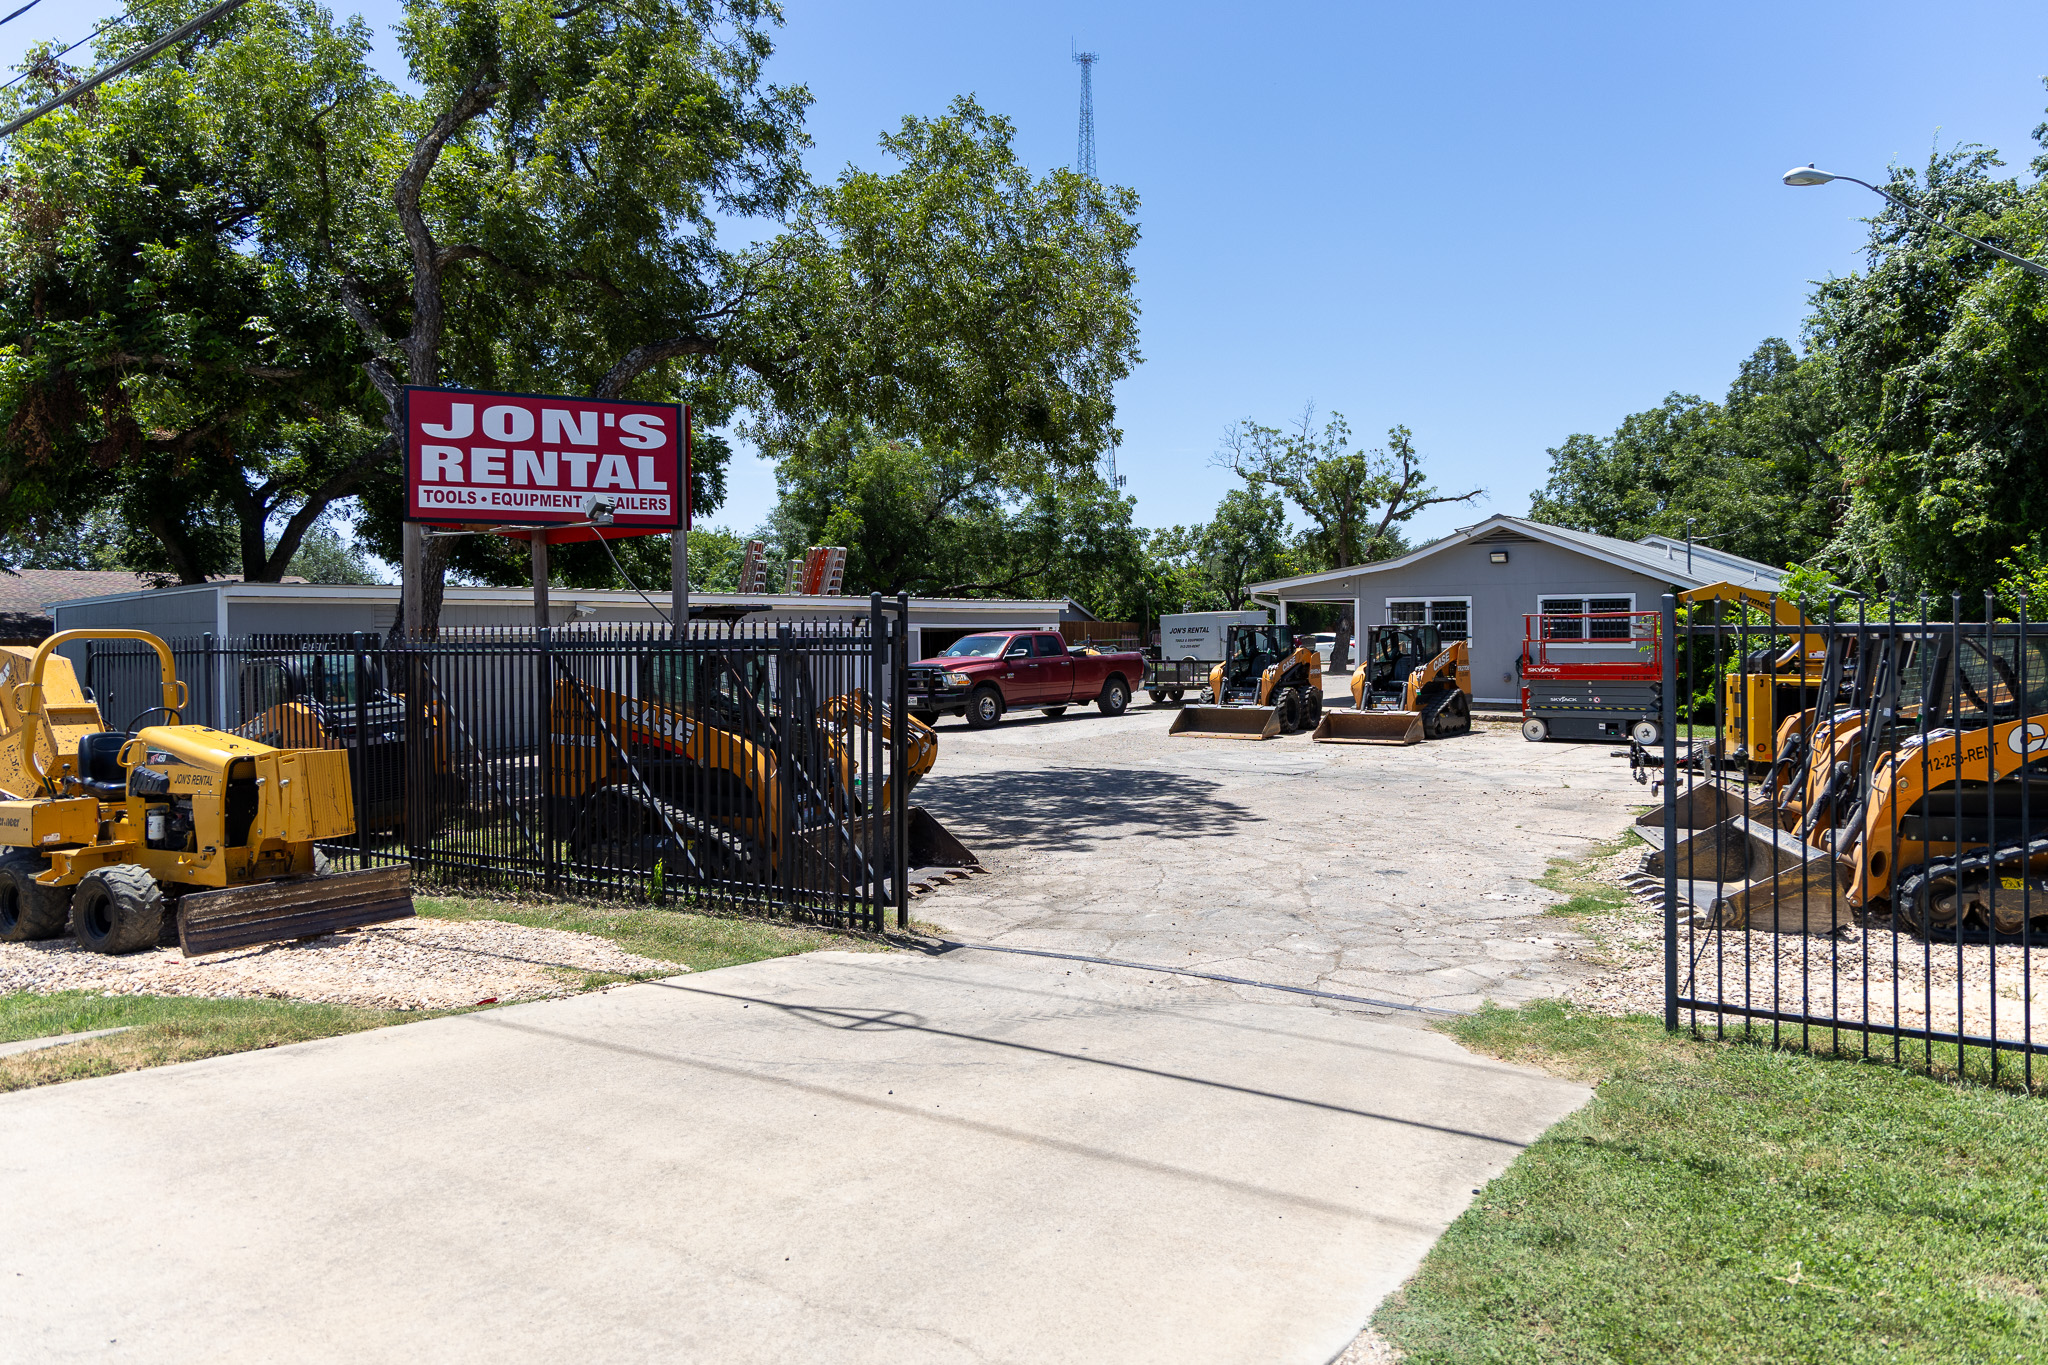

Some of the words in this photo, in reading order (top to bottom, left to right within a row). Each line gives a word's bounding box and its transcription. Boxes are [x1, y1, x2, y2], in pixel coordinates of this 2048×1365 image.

[421, 402, 667, 450] JON'S
[421, 445, 668, 491] RENTAL
[423, 489, 477, 505] TOOLS
[491, 492, 582, 508] EQUIPMENT
[615, 496, 667, 511] AILERS
[1169, 627, 1187, 635] JON'S
[1187, 626, 1210, 634] RENTAL
[1283, 656, 1297, 672] CASE
[1433, 651, 1450, 671] CASE
[1527, 665, 1561, 673] SKYJACK
[174, 774, 191, 785] JON'S
[191, 775, 213, 786] RENTAL
